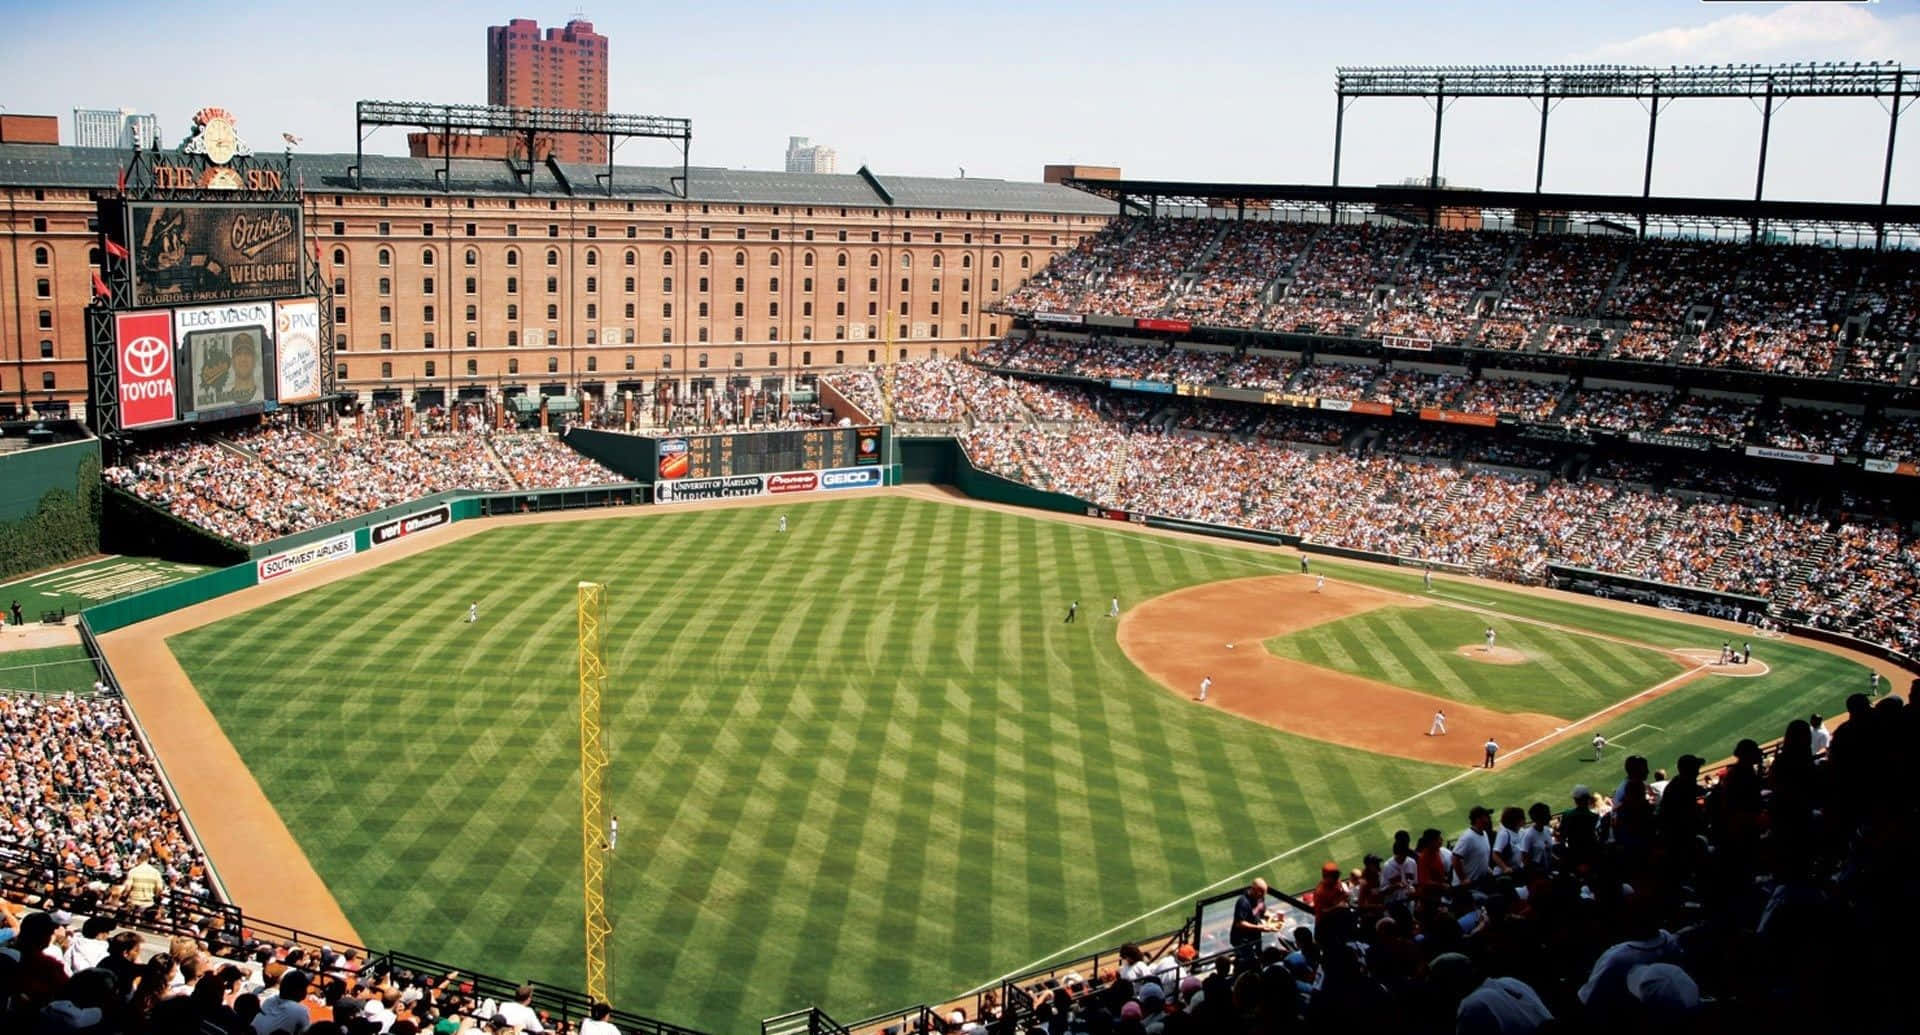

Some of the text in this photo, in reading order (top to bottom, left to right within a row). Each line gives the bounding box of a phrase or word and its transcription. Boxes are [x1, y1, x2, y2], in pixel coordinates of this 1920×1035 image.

[154, 167, 281, 191] THE SUN
[231, 210, 292, 249] Orioles
[230, 263, 297, 284] WELCOME!
[181, 306, 267, 327] LEGG MASON
[292, 313, 317, 328] PNC
[120, 378, 173, 402] TOYOTA
[673, 480, 712, 491] UNIVERSITY
[722, 477, 759, 488] MARYLAND
[772, 475, 817, 485] Pioneer
[823, 472, 869, 485] GEICO
[673, 490, 717, 501] MEDICAL
[721, 487, 759, 498] CENTER
[266, 540, 349, 574] SOUTHWEST AIRLINES
